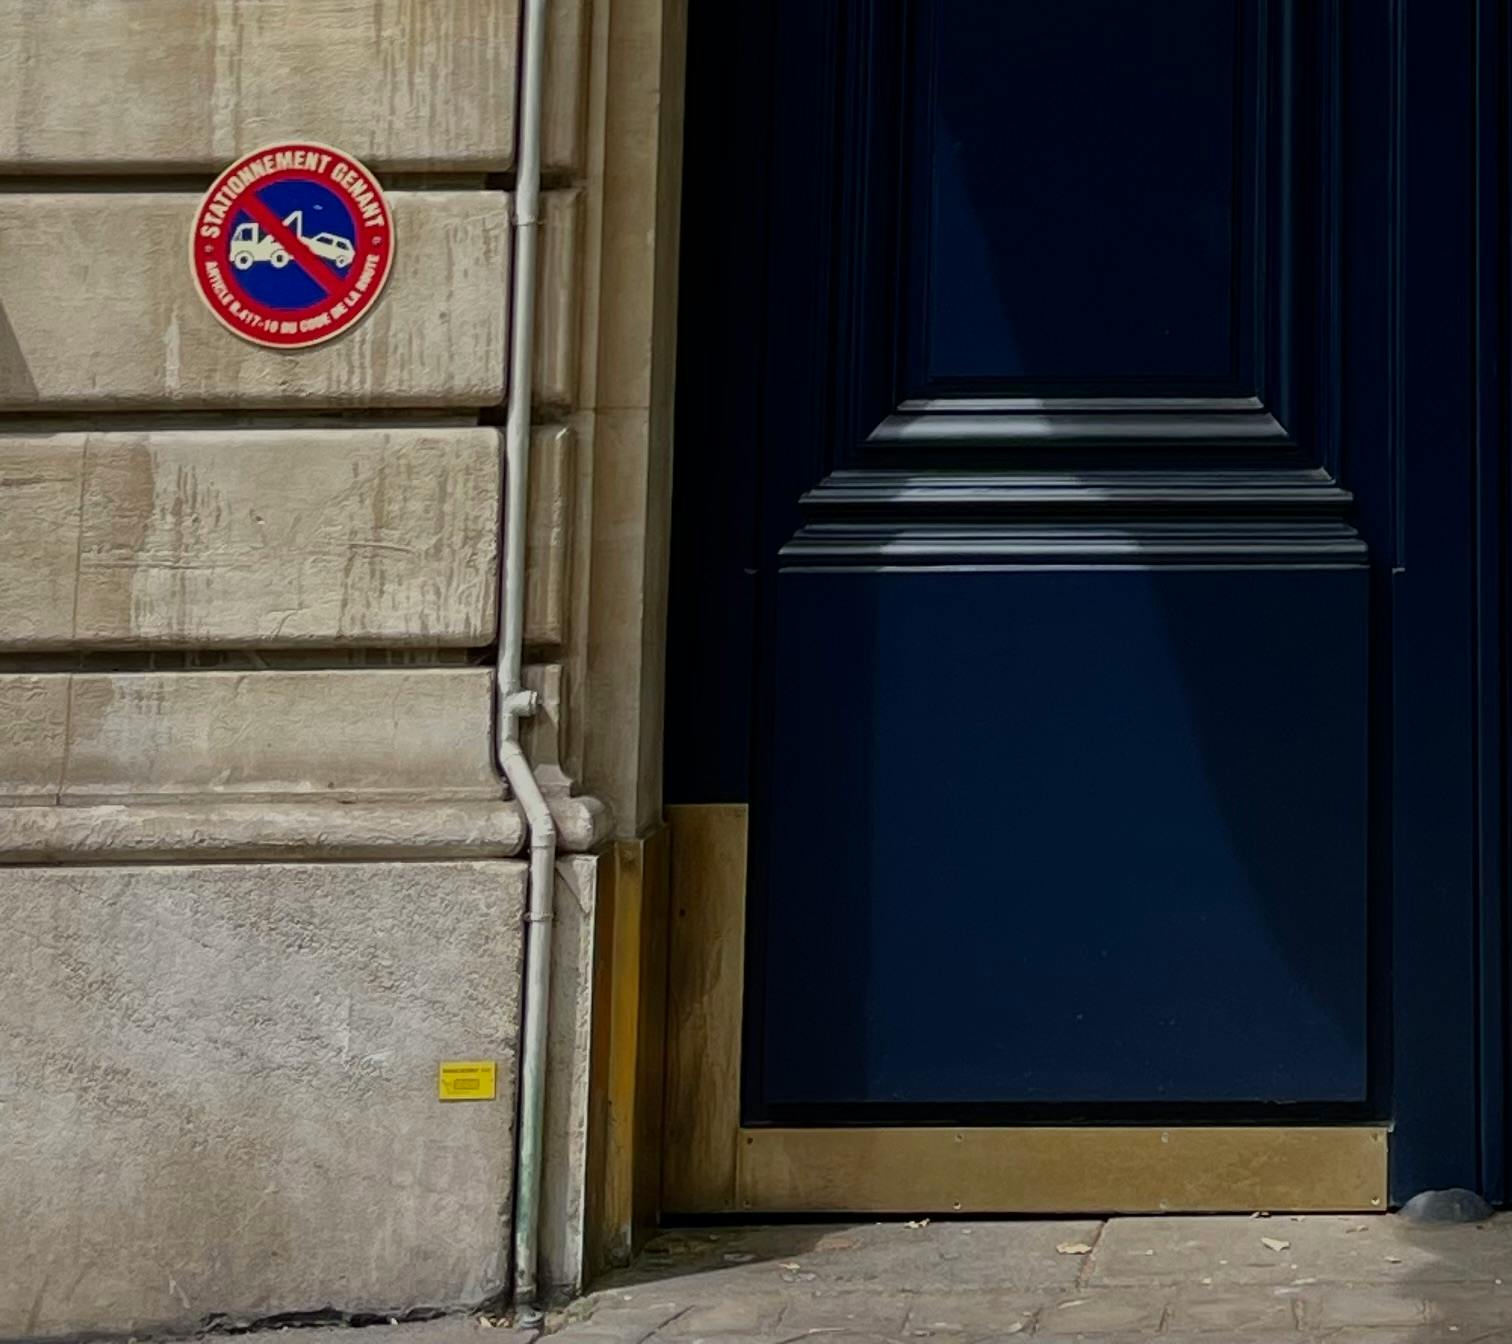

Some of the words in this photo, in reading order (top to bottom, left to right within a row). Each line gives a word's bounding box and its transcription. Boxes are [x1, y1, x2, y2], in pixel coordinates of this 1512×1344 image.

[200, 150, 333, 239] STATIONNEMENT
[331, 162, 385, 229] GENANT
[331, 304, 348, 319] DE
[344, 291, 362, 307] LA
